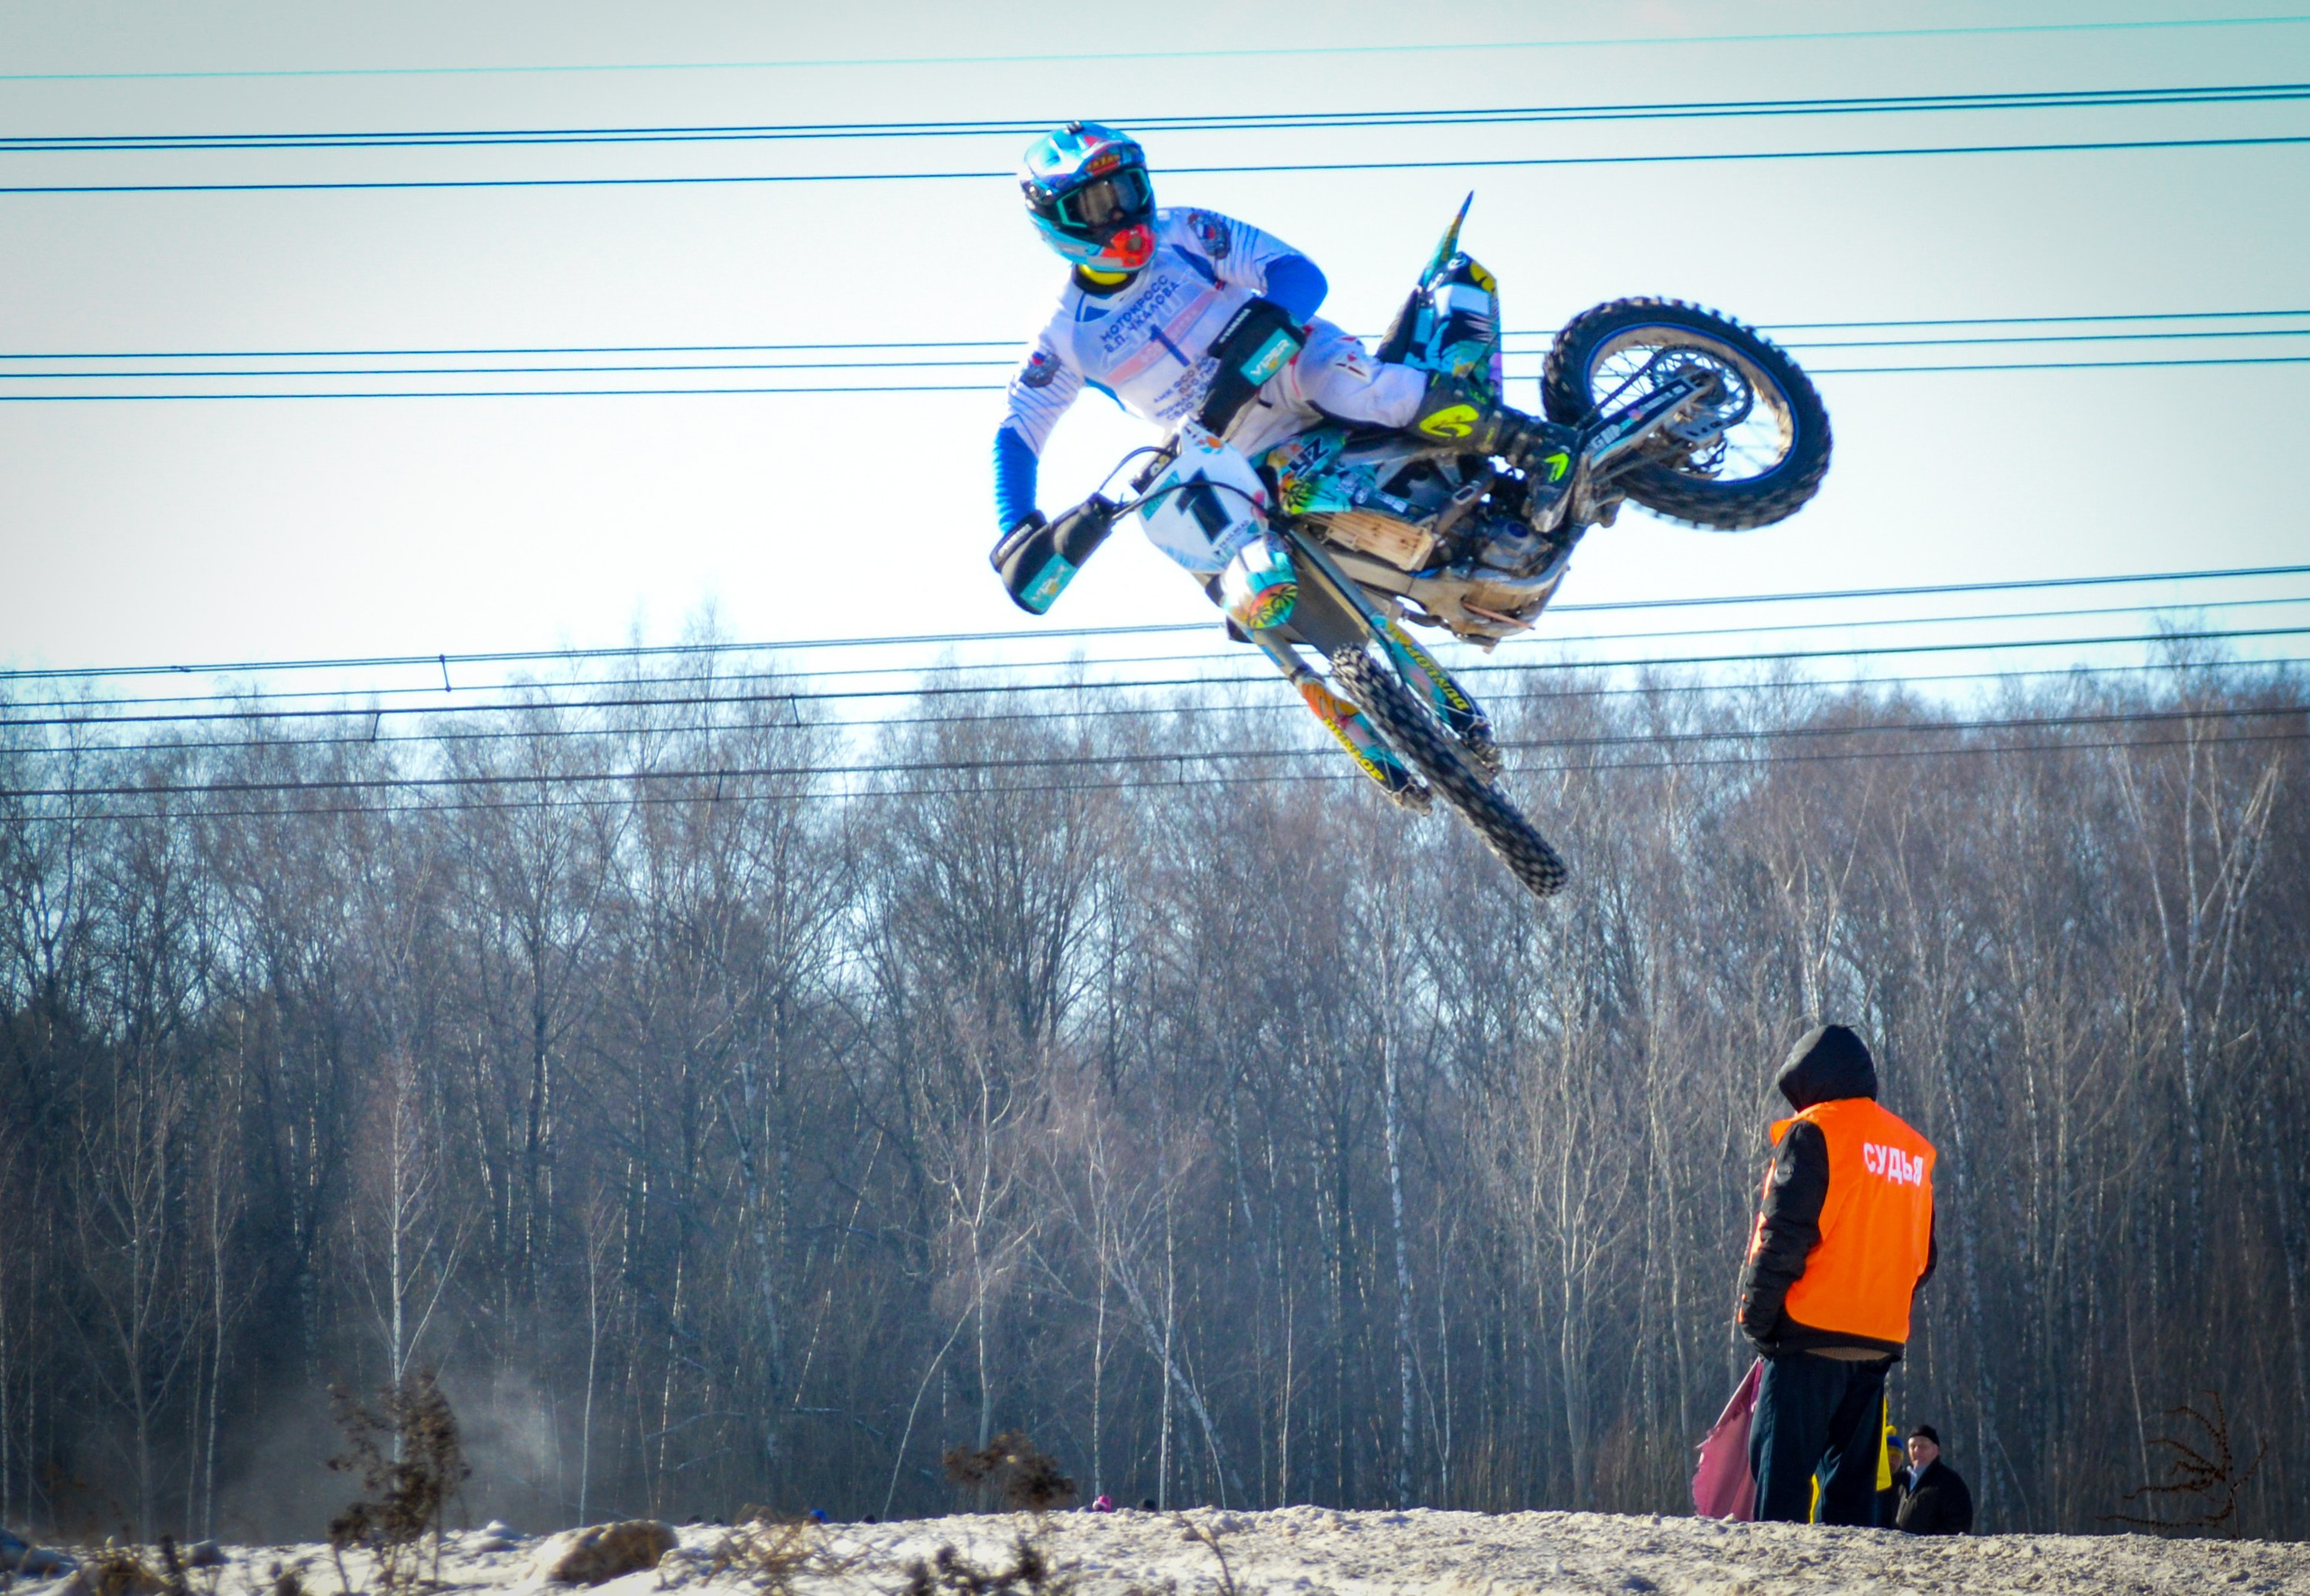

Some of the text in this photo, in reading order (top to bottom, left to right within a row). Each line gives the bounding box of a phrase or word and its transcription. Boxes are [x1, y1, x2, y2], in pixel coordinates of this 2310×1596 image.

[1101, 274, 1169, 341] МОТОКРОСС
[1127, 281, 1179, 330] ЧКАЛОВА
[1149, 323, 1191, 368] 1
[1250, 338, 1290, 375] VIPER
[1405, 646, 1470, 711] DUNLOP
[1323, 716, 1386, 781] DUNLOP
[1863, 1141, 1924, 1187] СУДЬЯ
